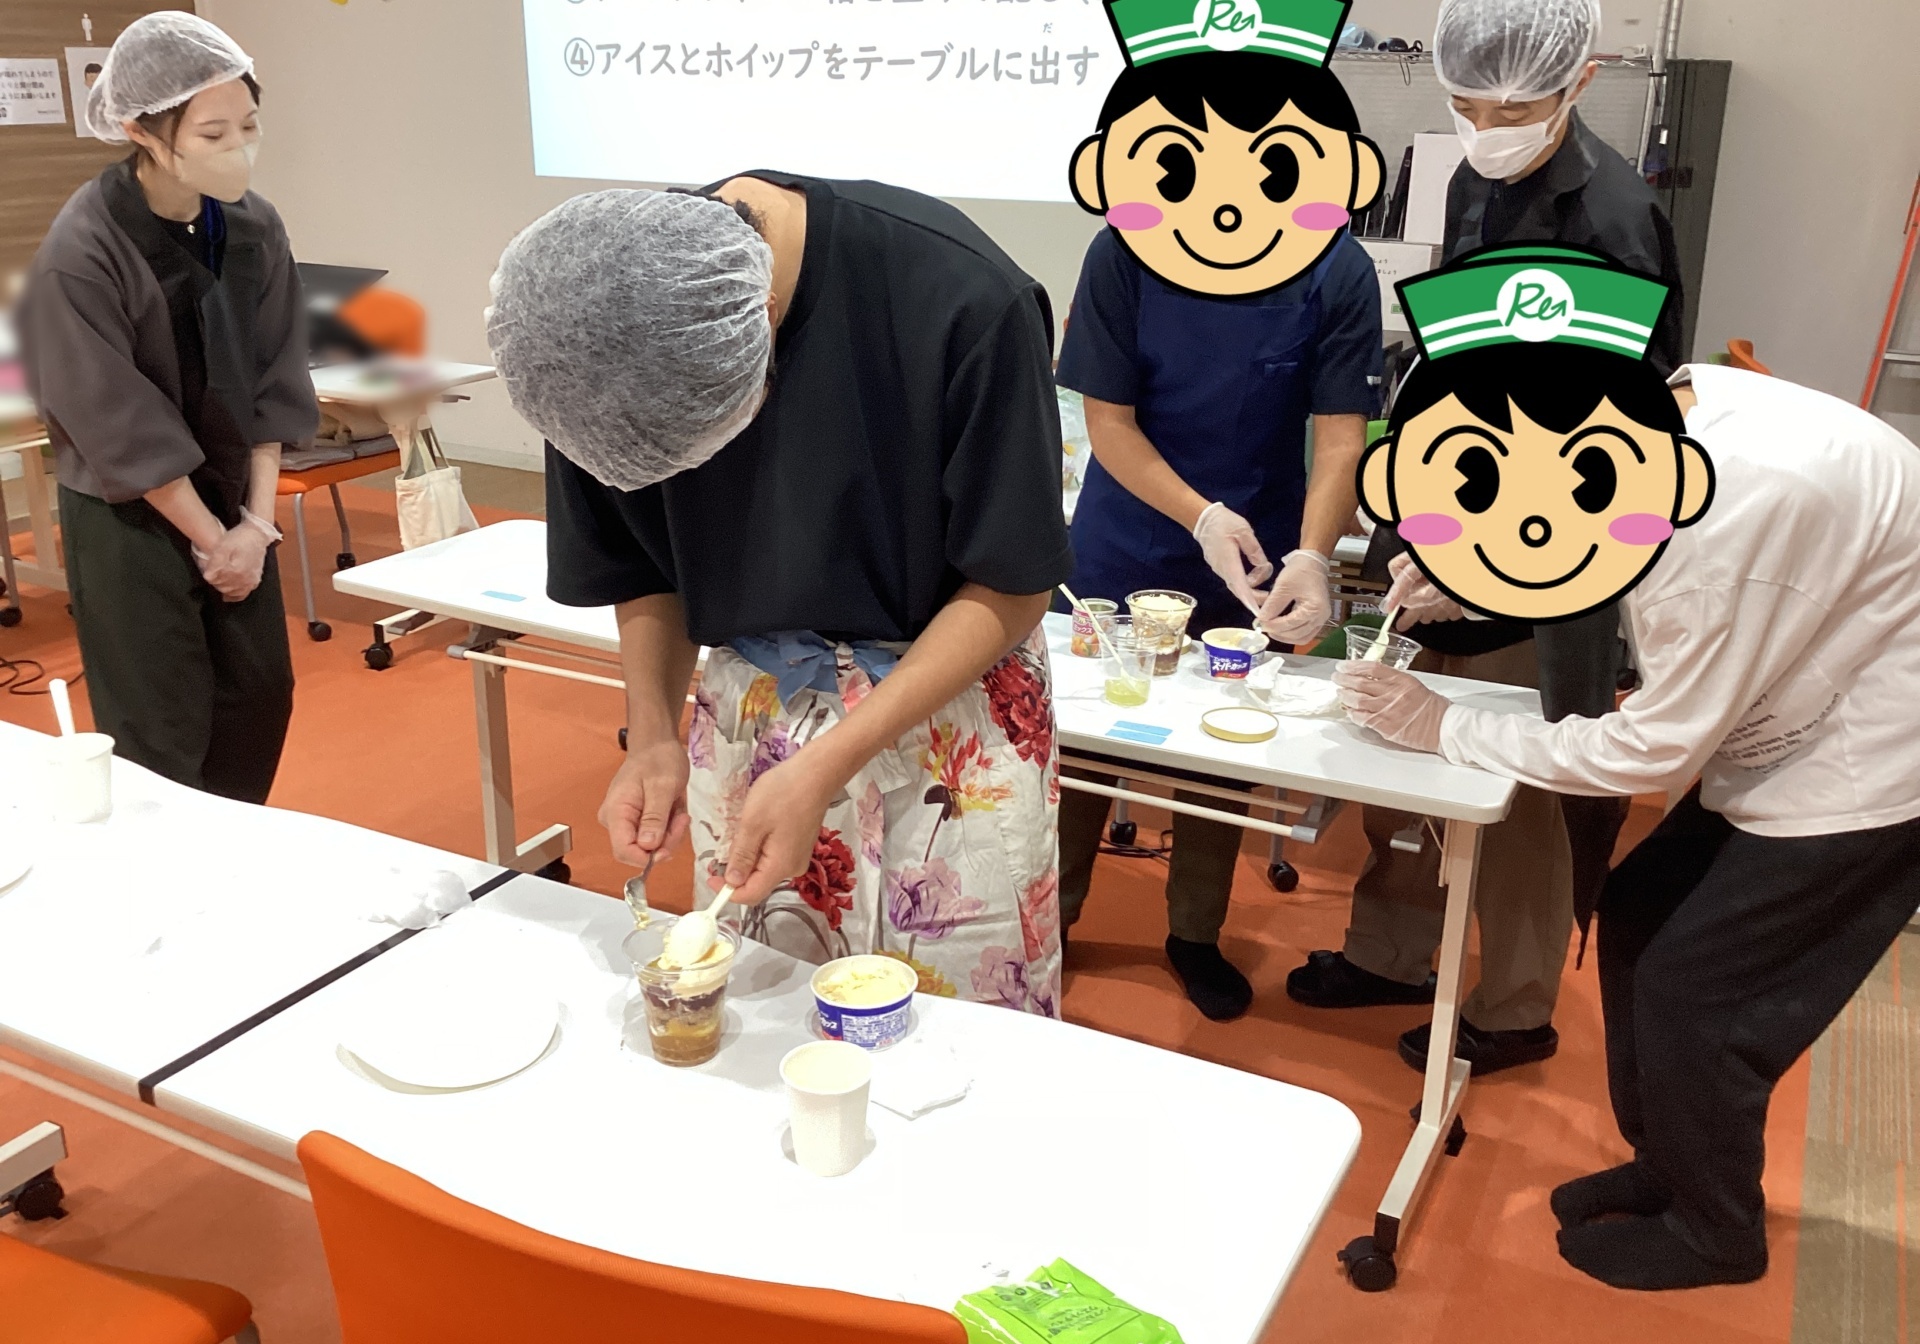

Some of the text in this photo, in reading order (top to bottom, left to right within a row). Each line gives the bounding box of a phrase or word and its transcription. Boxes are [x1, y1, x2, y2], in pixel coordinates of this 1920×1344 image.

[1043, 23, 1054, 34] だ
[1211, 661, 1248, 671] スーパーカップ
